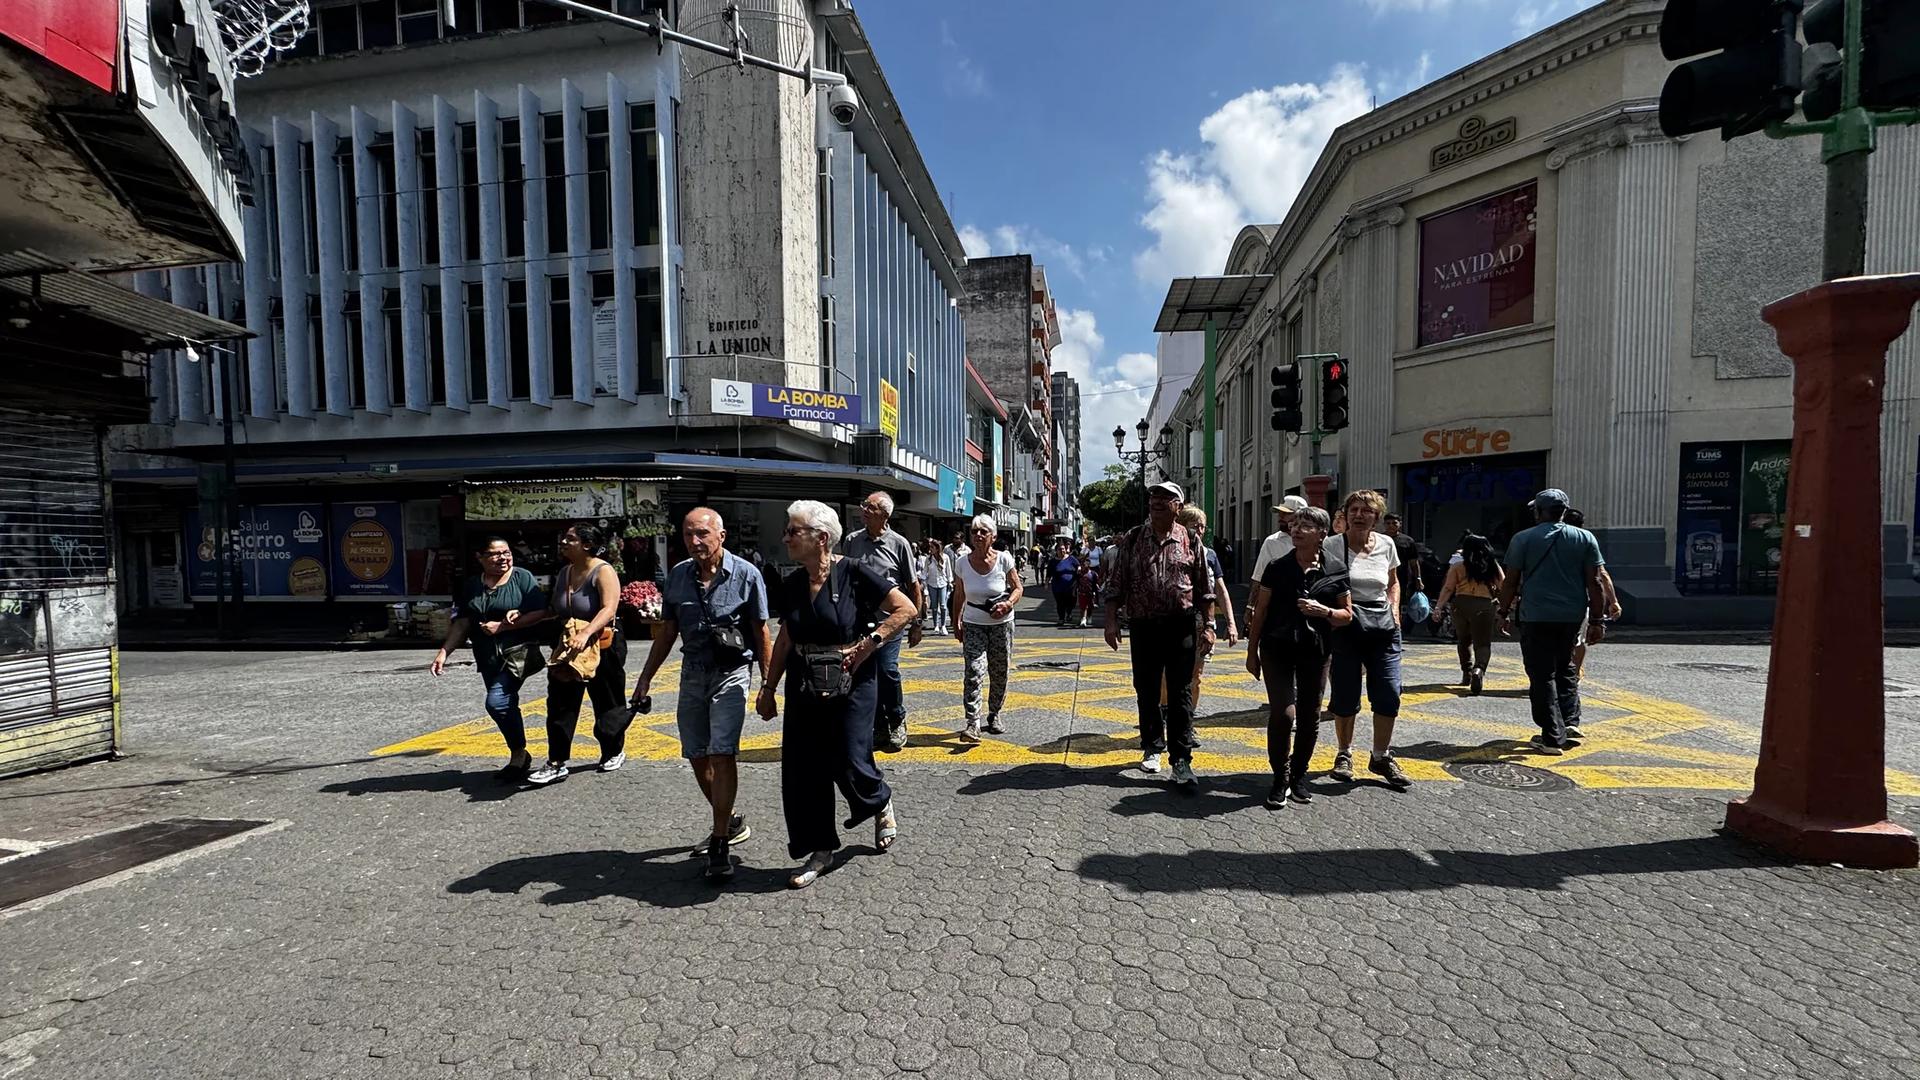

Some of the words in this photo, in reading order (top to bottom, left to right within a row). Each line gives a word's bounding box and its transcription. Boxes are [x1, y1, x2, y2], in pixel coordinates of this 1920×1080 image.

[1437, 127, 1511, 165] ekono
[1433, 243, 1524, 284] NAVIDAD
[1440, 277, 1463, 291] PARA
[1466, 266, 1516, 285] ESTRENAR
[708, 319, 759, 333] EDIFICIO
[696, 340, 718, 355] LA
[721, 336, 771, 354] UNION
[768, 388, 790, 404] LA
[791, 389, 848, 410] BOMBA
[783, 404, 835, 421] Farmacia
[1423, 430, 1511, 459] Sucre
[1696, 451, 1722, 459] TUMS
[1686, 471, 1712, 480] ALIVIA
[1714, 471, 1731, 479] LOS
[511, 487, 531, 495] Pipa
[555, 485, 583, 494] Frutas
[1405, 466, 1536, 503] Sucre
[549, 496, 577, 504] Naranja
[239, 520, 269, 532] Salud
[258, 549, 271, 560] de
[272, 551, 291, 560] vos
